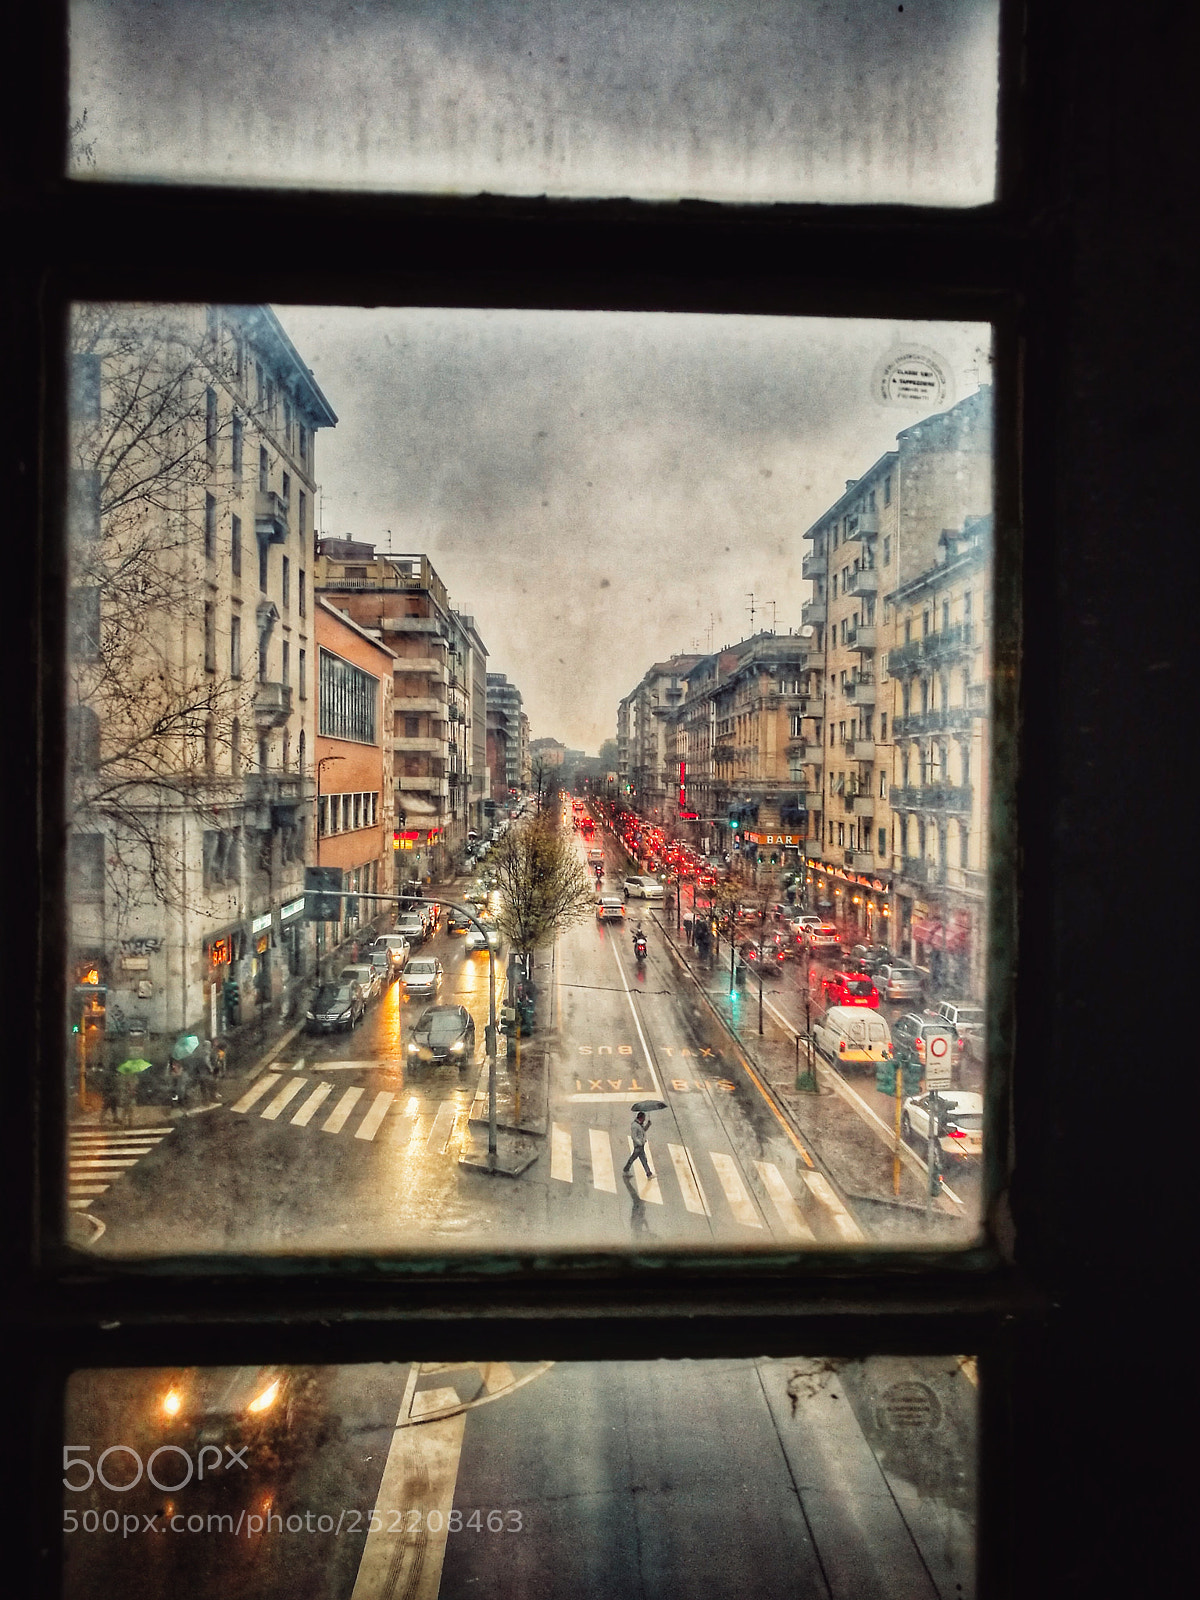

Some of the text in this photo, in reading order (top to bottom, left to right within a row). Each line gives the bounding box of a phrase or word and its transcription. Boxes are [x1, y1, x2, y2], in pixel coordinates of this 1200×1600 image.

[767, 835, 793, 845] BAR
[212, 946, 227, 967] BAR
[578, 1045, 633, 1055] BUS
[660, 1047, 725, 1057] TAXI
[575, 1078, 643, 1091] TAXI
[671, 1079, 736, 1091] BUS
